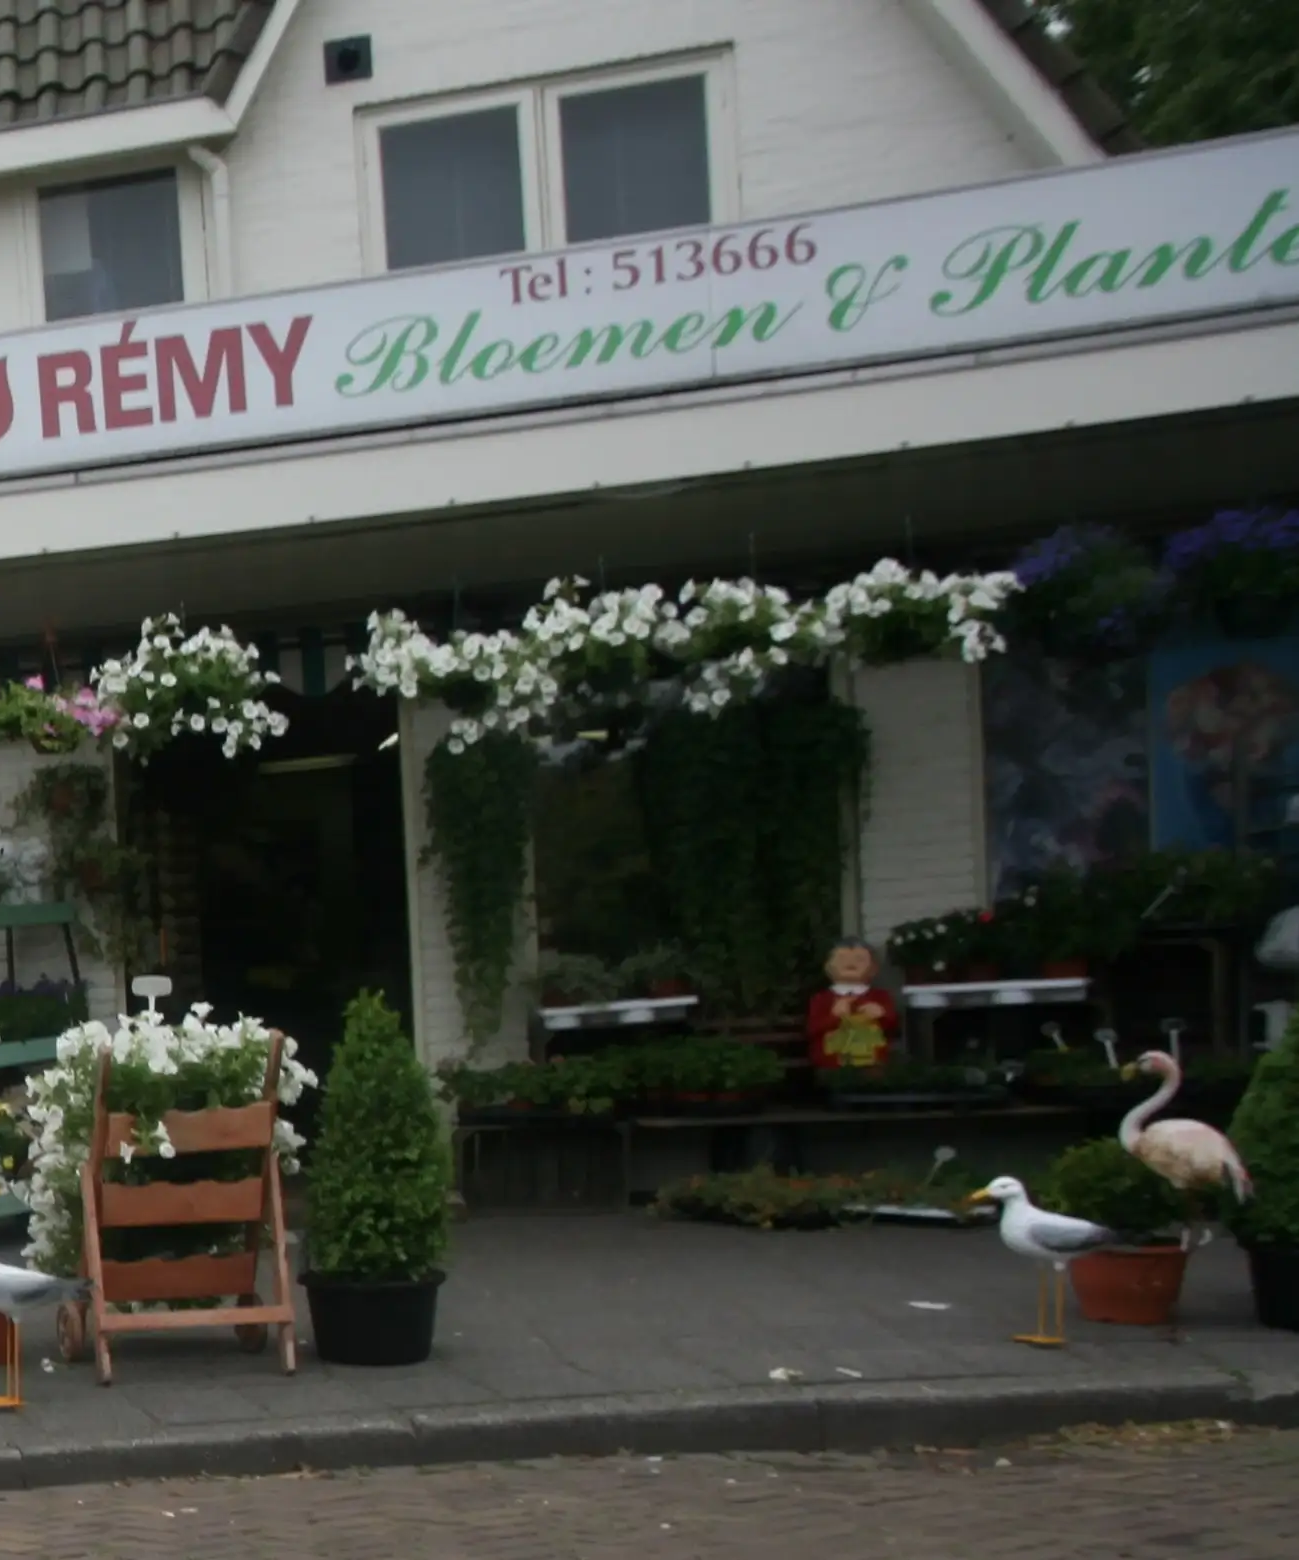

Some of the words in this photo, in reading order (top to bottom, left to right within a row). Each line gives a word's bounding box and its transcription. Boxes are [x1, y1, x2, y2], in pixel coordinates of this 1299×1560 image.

[611, 223, 818, 291] 513666
[36, 315, 314, 440] RÉMY
[335, 301, 803, 399] Bloemen
[825, 255, 909, 332] &
